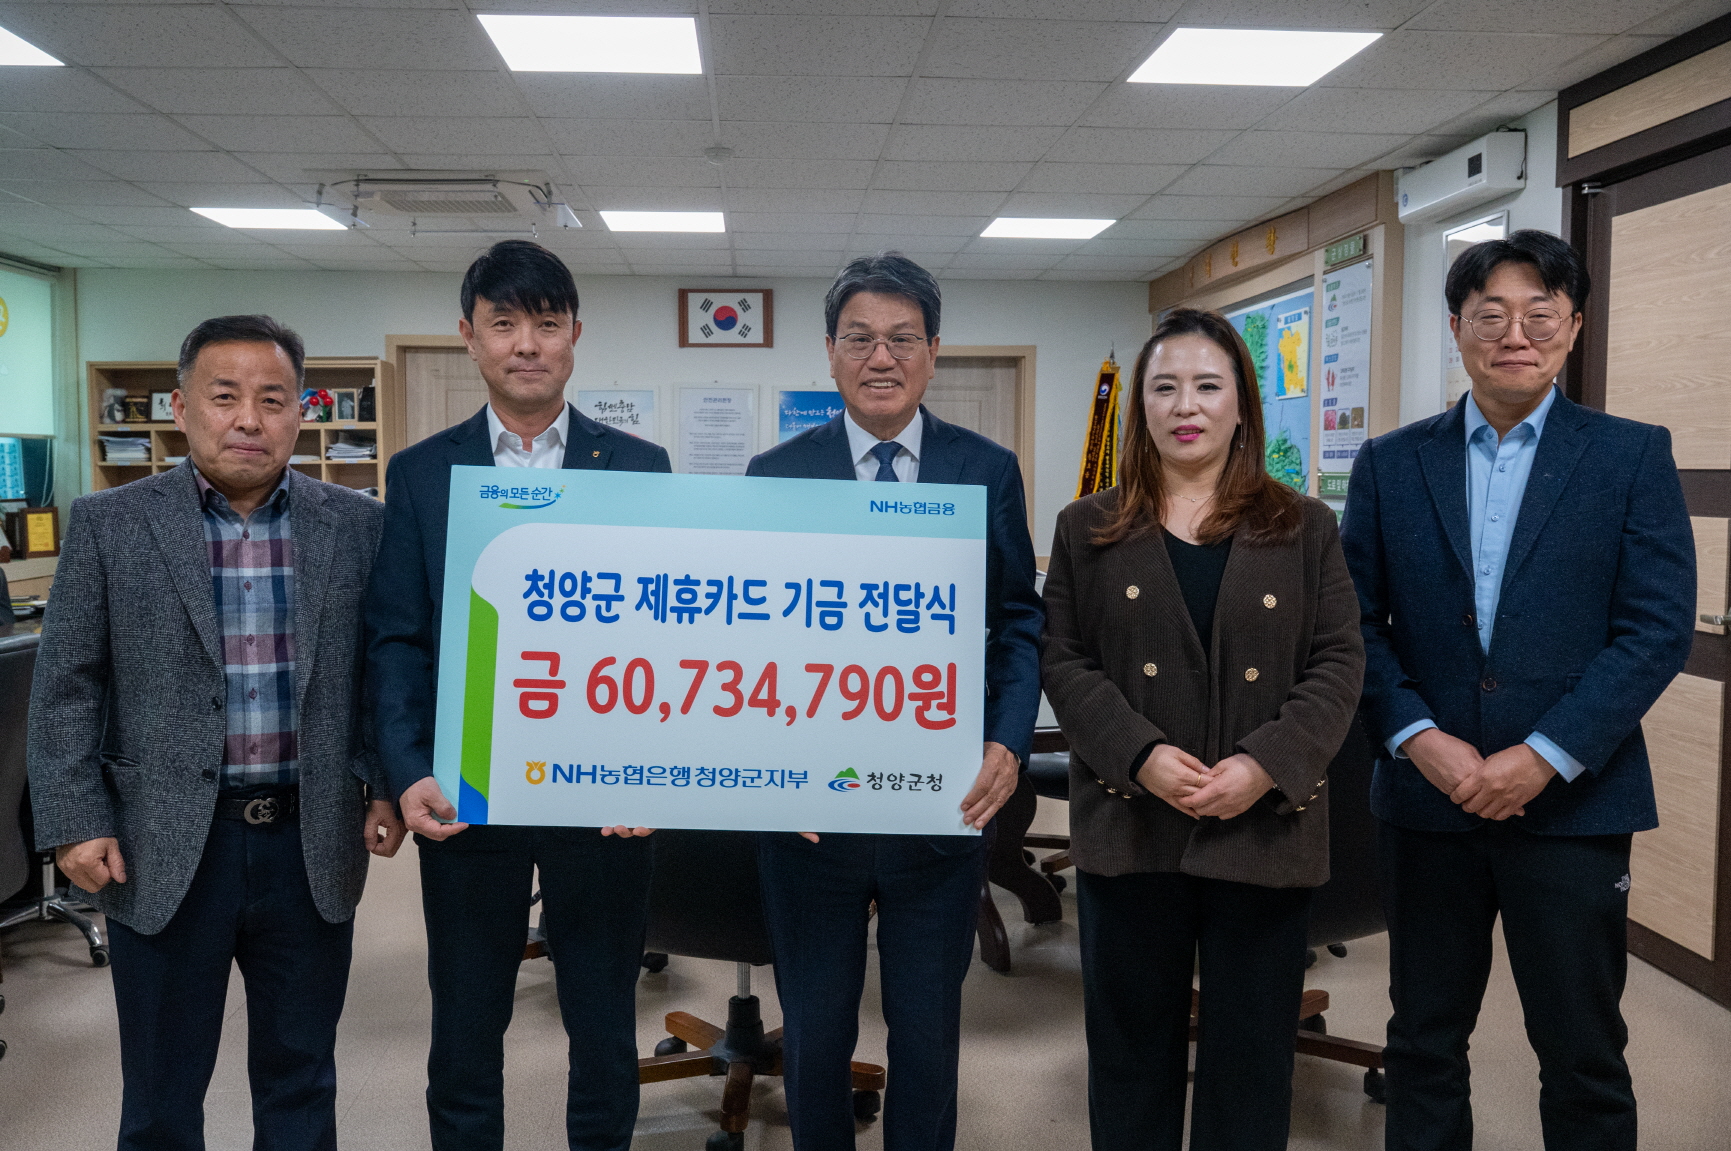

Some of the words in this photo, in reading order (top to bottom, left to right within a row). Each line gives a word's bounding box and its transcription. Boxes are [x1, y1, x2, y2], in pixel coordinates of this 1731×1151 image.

[479, 485, 508, 499] 금융의
[509, 487, 530, 500] 모든
[530, 487, 553, 501] 순간
[870, 500, 955, 516] NH농협금융
[522, 568, 625, 624] 청양군
[635, 573, 771, 626] 제휴카드
[782, 577, 848, 631] 기금
[858, 581, 956, 635] 전달식
[513, 651, 566, 719] 금
[586, 656, 957, 730] 60,734,790원
[866, 771, 943, 792] 청양군청
